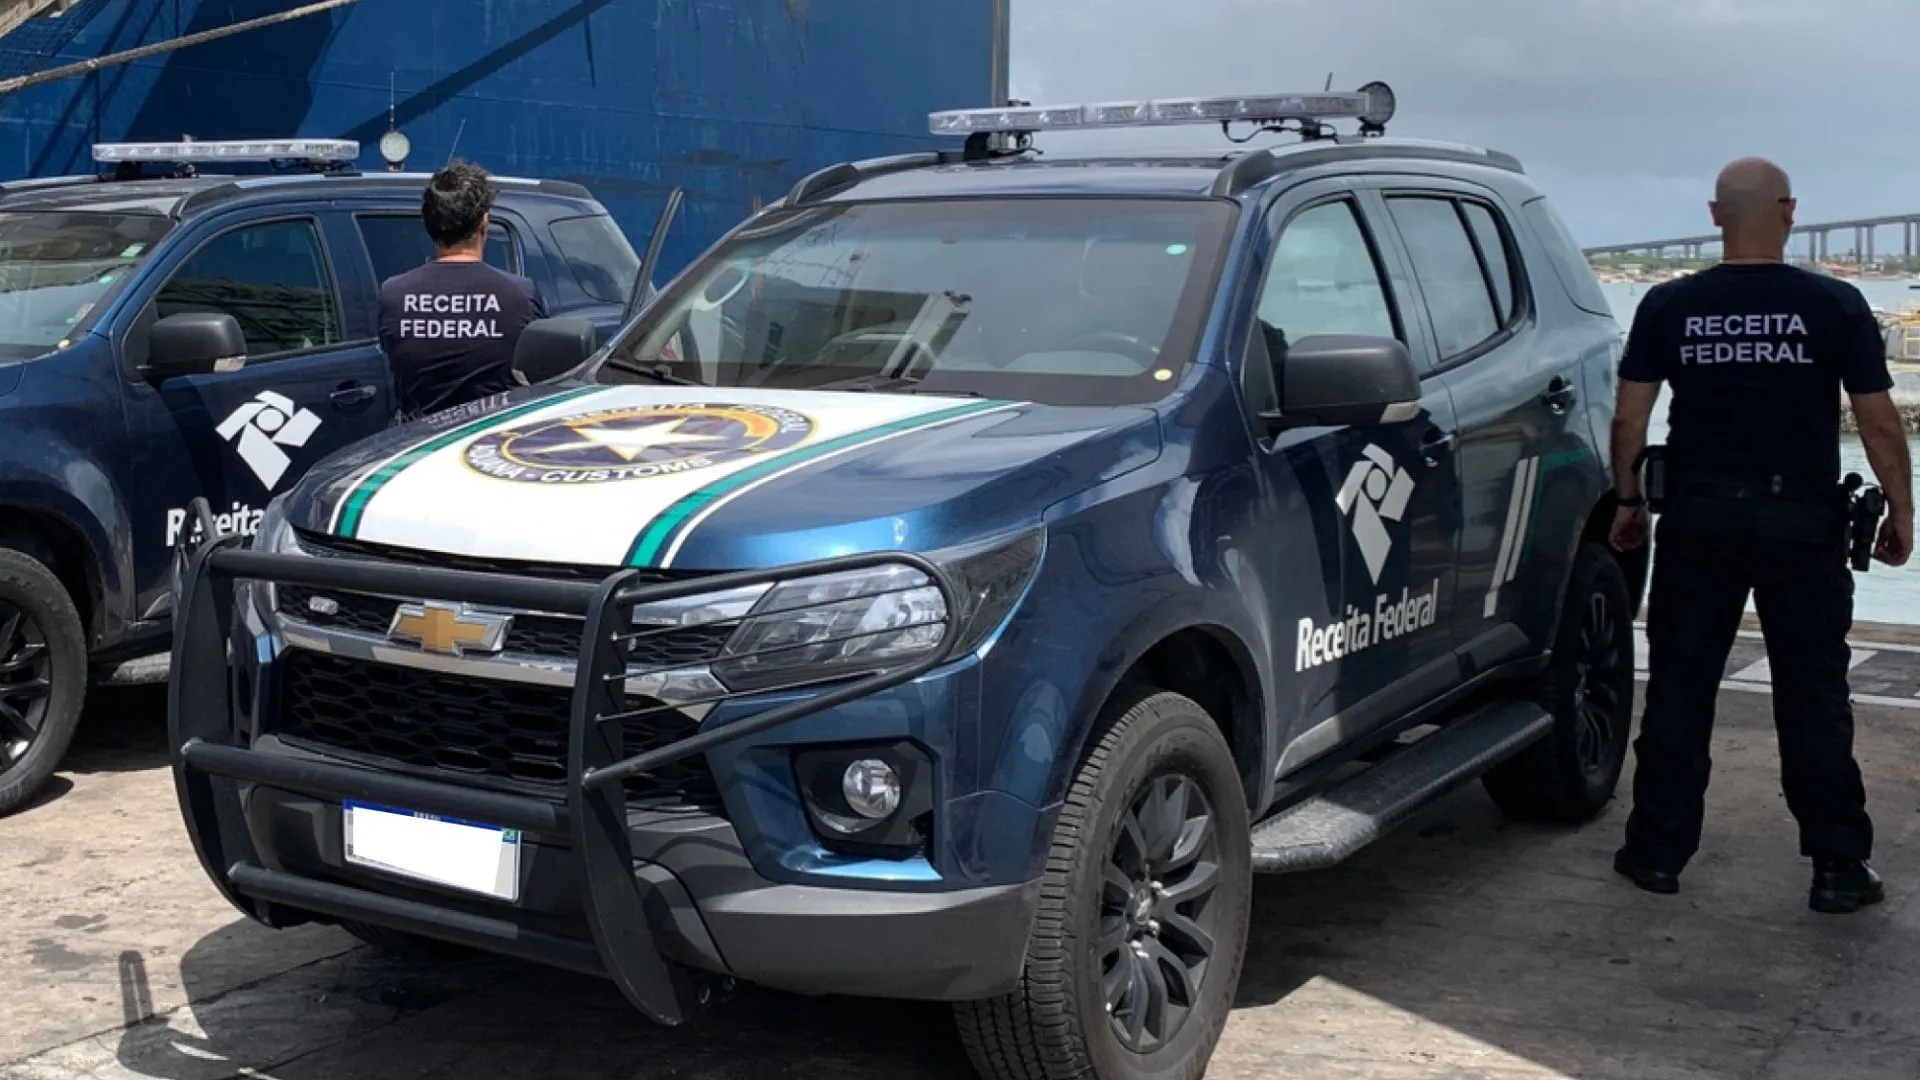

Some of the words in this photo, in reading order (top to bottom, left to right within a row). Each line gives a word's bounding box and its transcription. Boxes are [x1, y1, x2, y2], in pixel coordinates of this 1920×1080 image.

[403, 293, 501, 313] RECEITA
[400, 318, 504, 339] FEDERAL
[1684, 313, 1808, 337] RECEITA
[1679, 341, 1814, 366] FEDERAL
[540, 457, 713, 483] CUSTOMS
[165, 501, 265, 548] Reita
[1295, 604, 1371, 672] Receita
[1372, 577, 1439, 644] Federal
